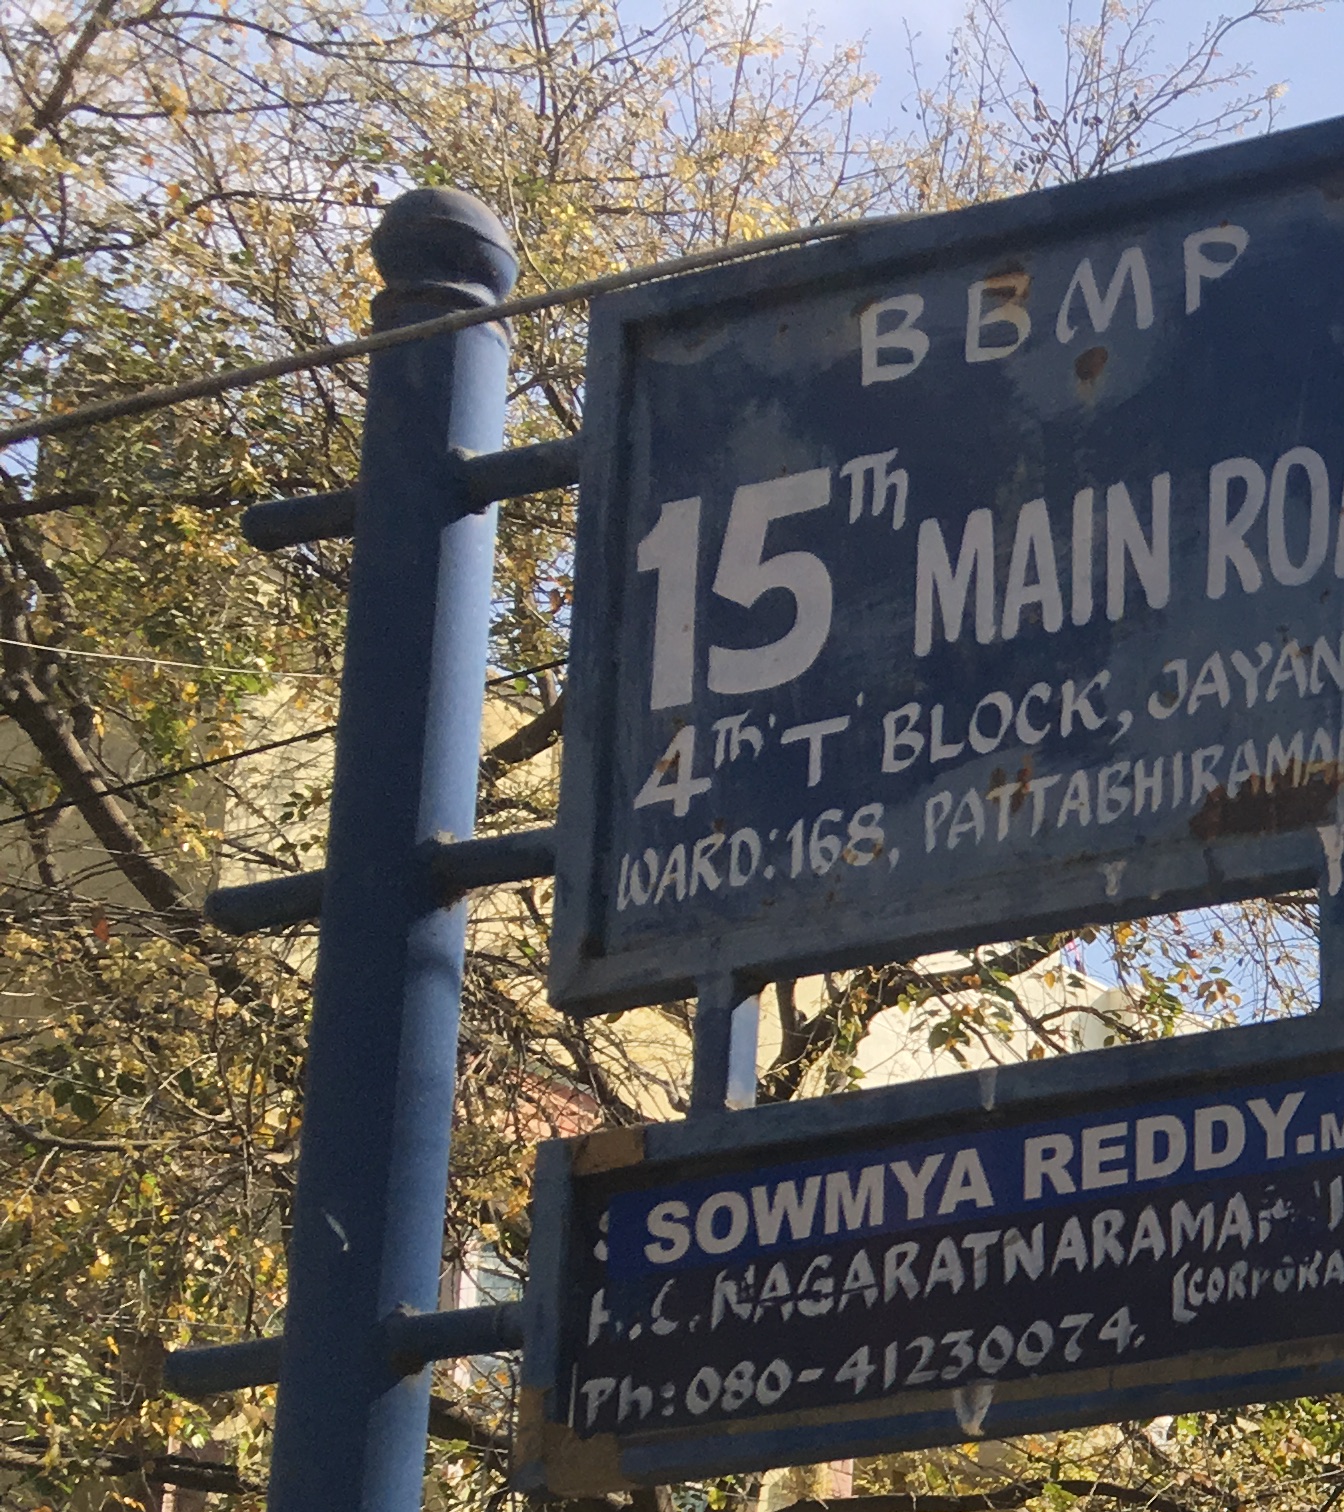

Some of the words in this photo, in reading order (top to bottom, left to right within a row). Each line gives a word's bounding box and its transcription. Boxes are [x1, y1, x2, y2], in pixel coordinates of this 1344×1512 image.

[912, 471, 1172, 659] MAIN
[880, 668, 1134, 774] BLOCK,
[643, 1148, 995, 1266] SOWMYA
